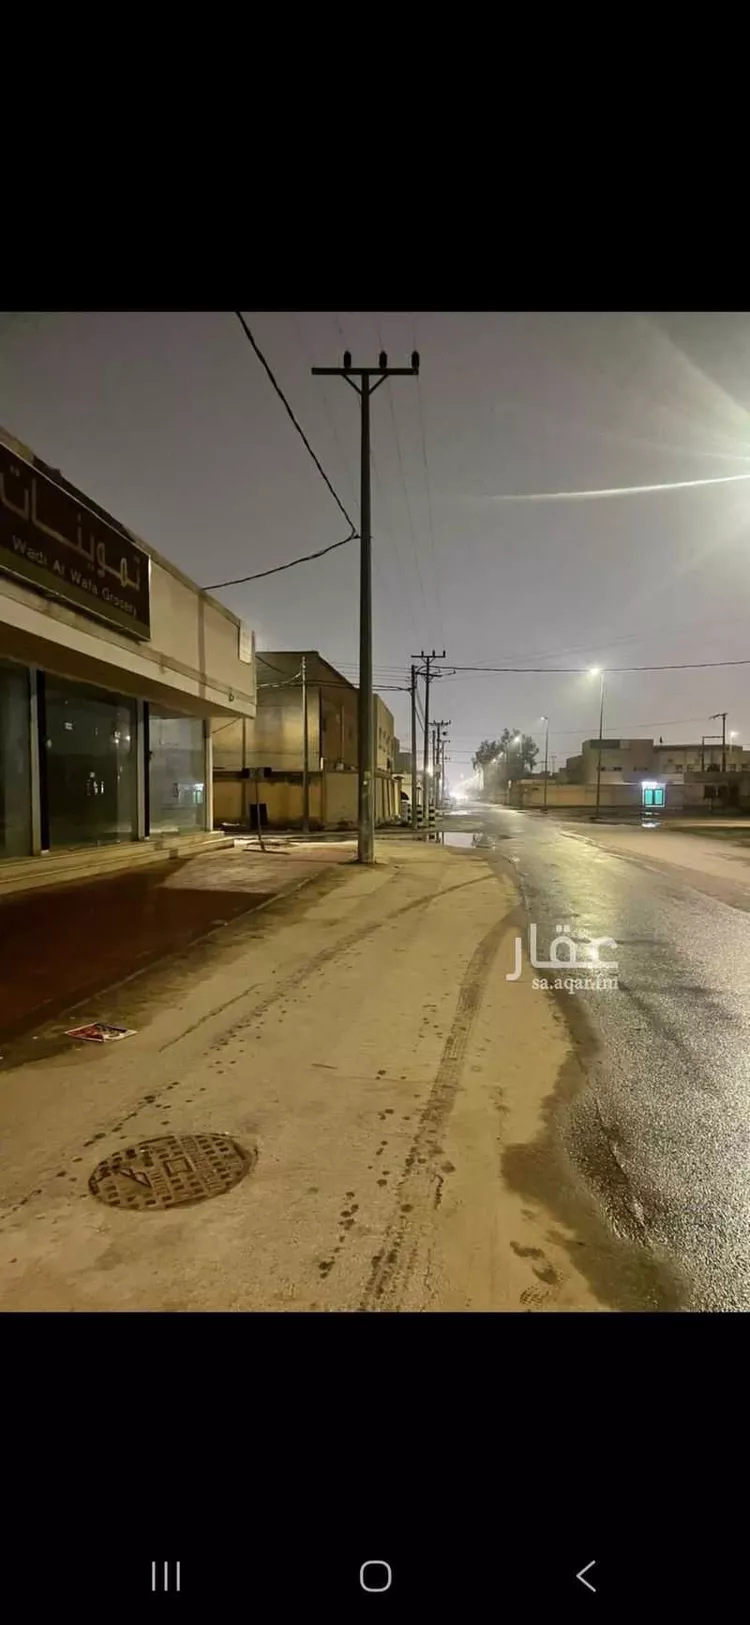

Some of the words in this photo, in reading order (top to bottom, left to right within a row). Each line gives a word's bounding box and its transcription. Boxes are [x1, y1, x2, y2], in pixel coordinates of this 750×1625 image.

[12, 535, 47, 565] Wadi
[53, 560, 65, 576] Al
[70, 567, 98, 595] Wafa
